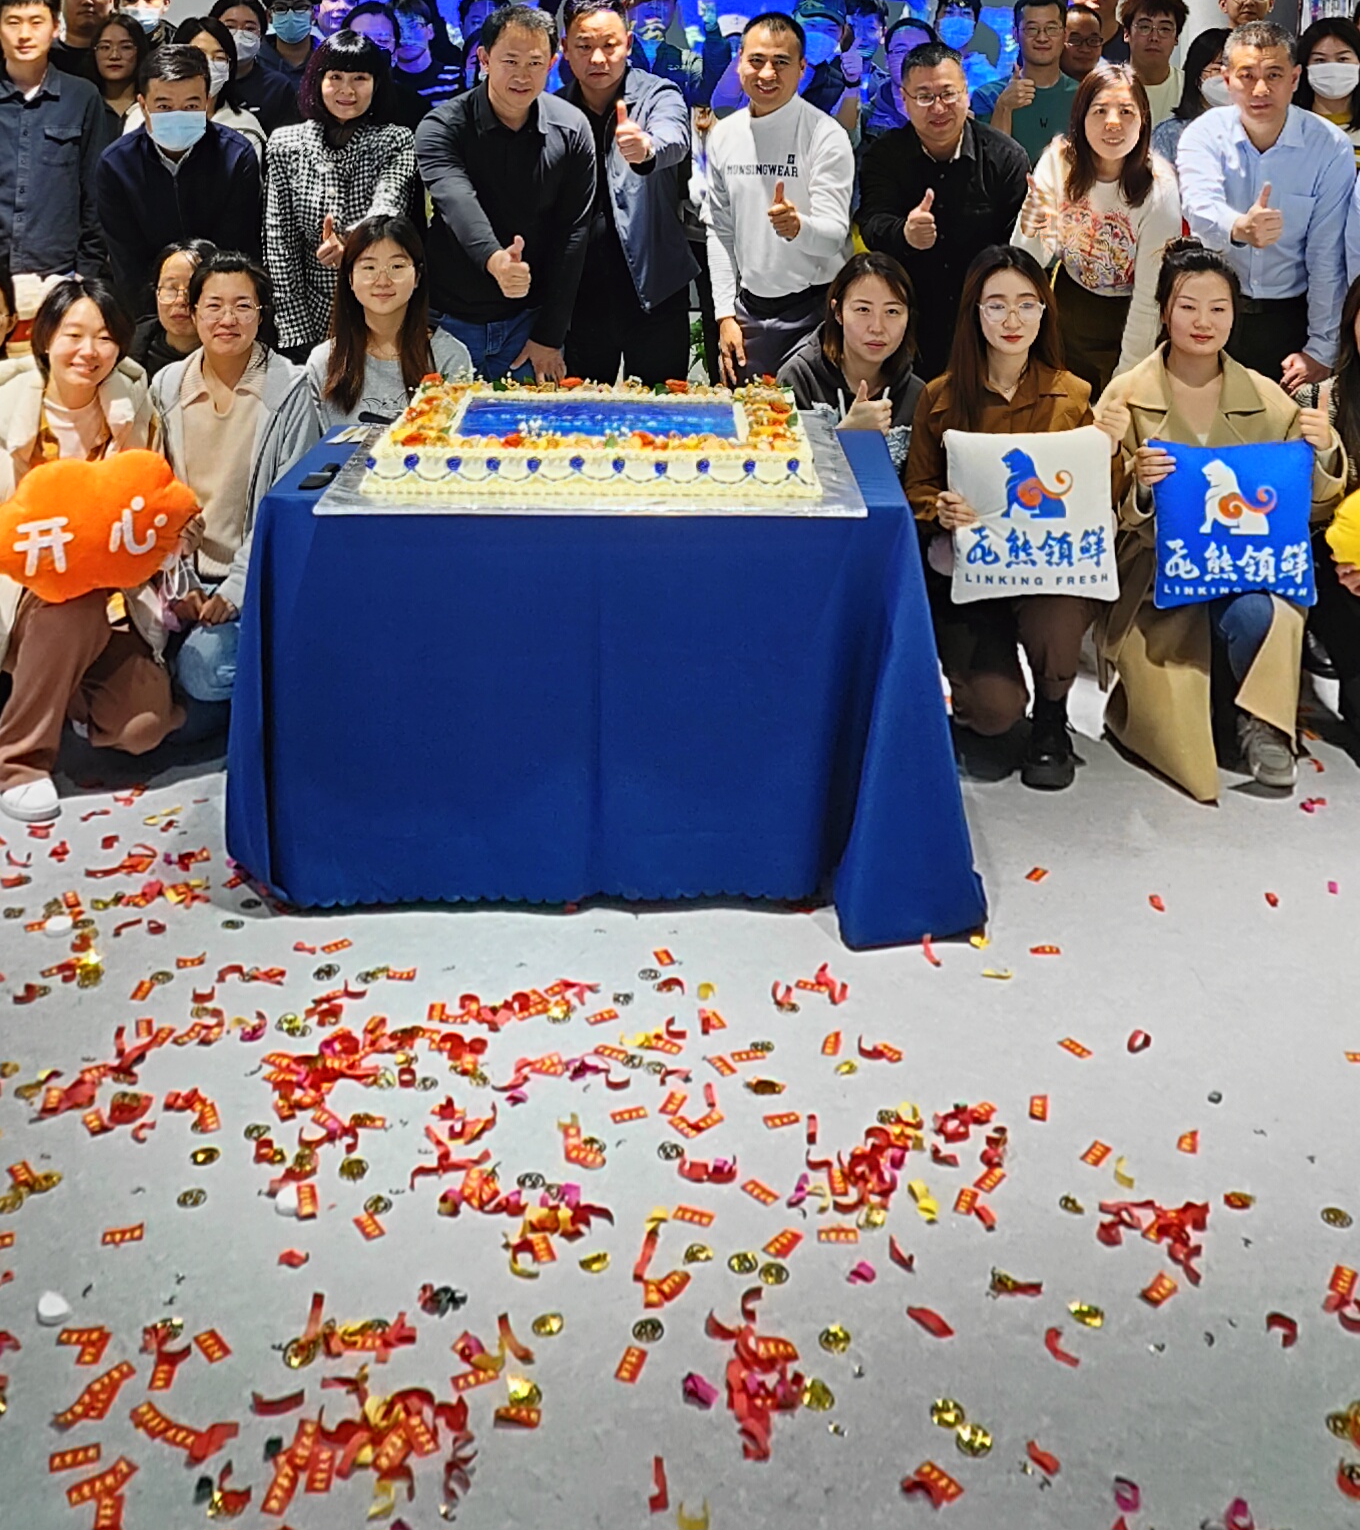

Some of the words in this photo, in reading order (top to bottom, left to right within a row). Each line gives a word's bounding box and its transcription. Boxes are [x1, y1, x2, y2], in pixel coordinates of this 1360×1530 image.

[726, 164, 798, 177] MUNSINGWEAR
[13, 496, 168, 577] 开心
[965, 573, 1044, 586] LINKING
[1055, 573, 1109, 586] FRESH
